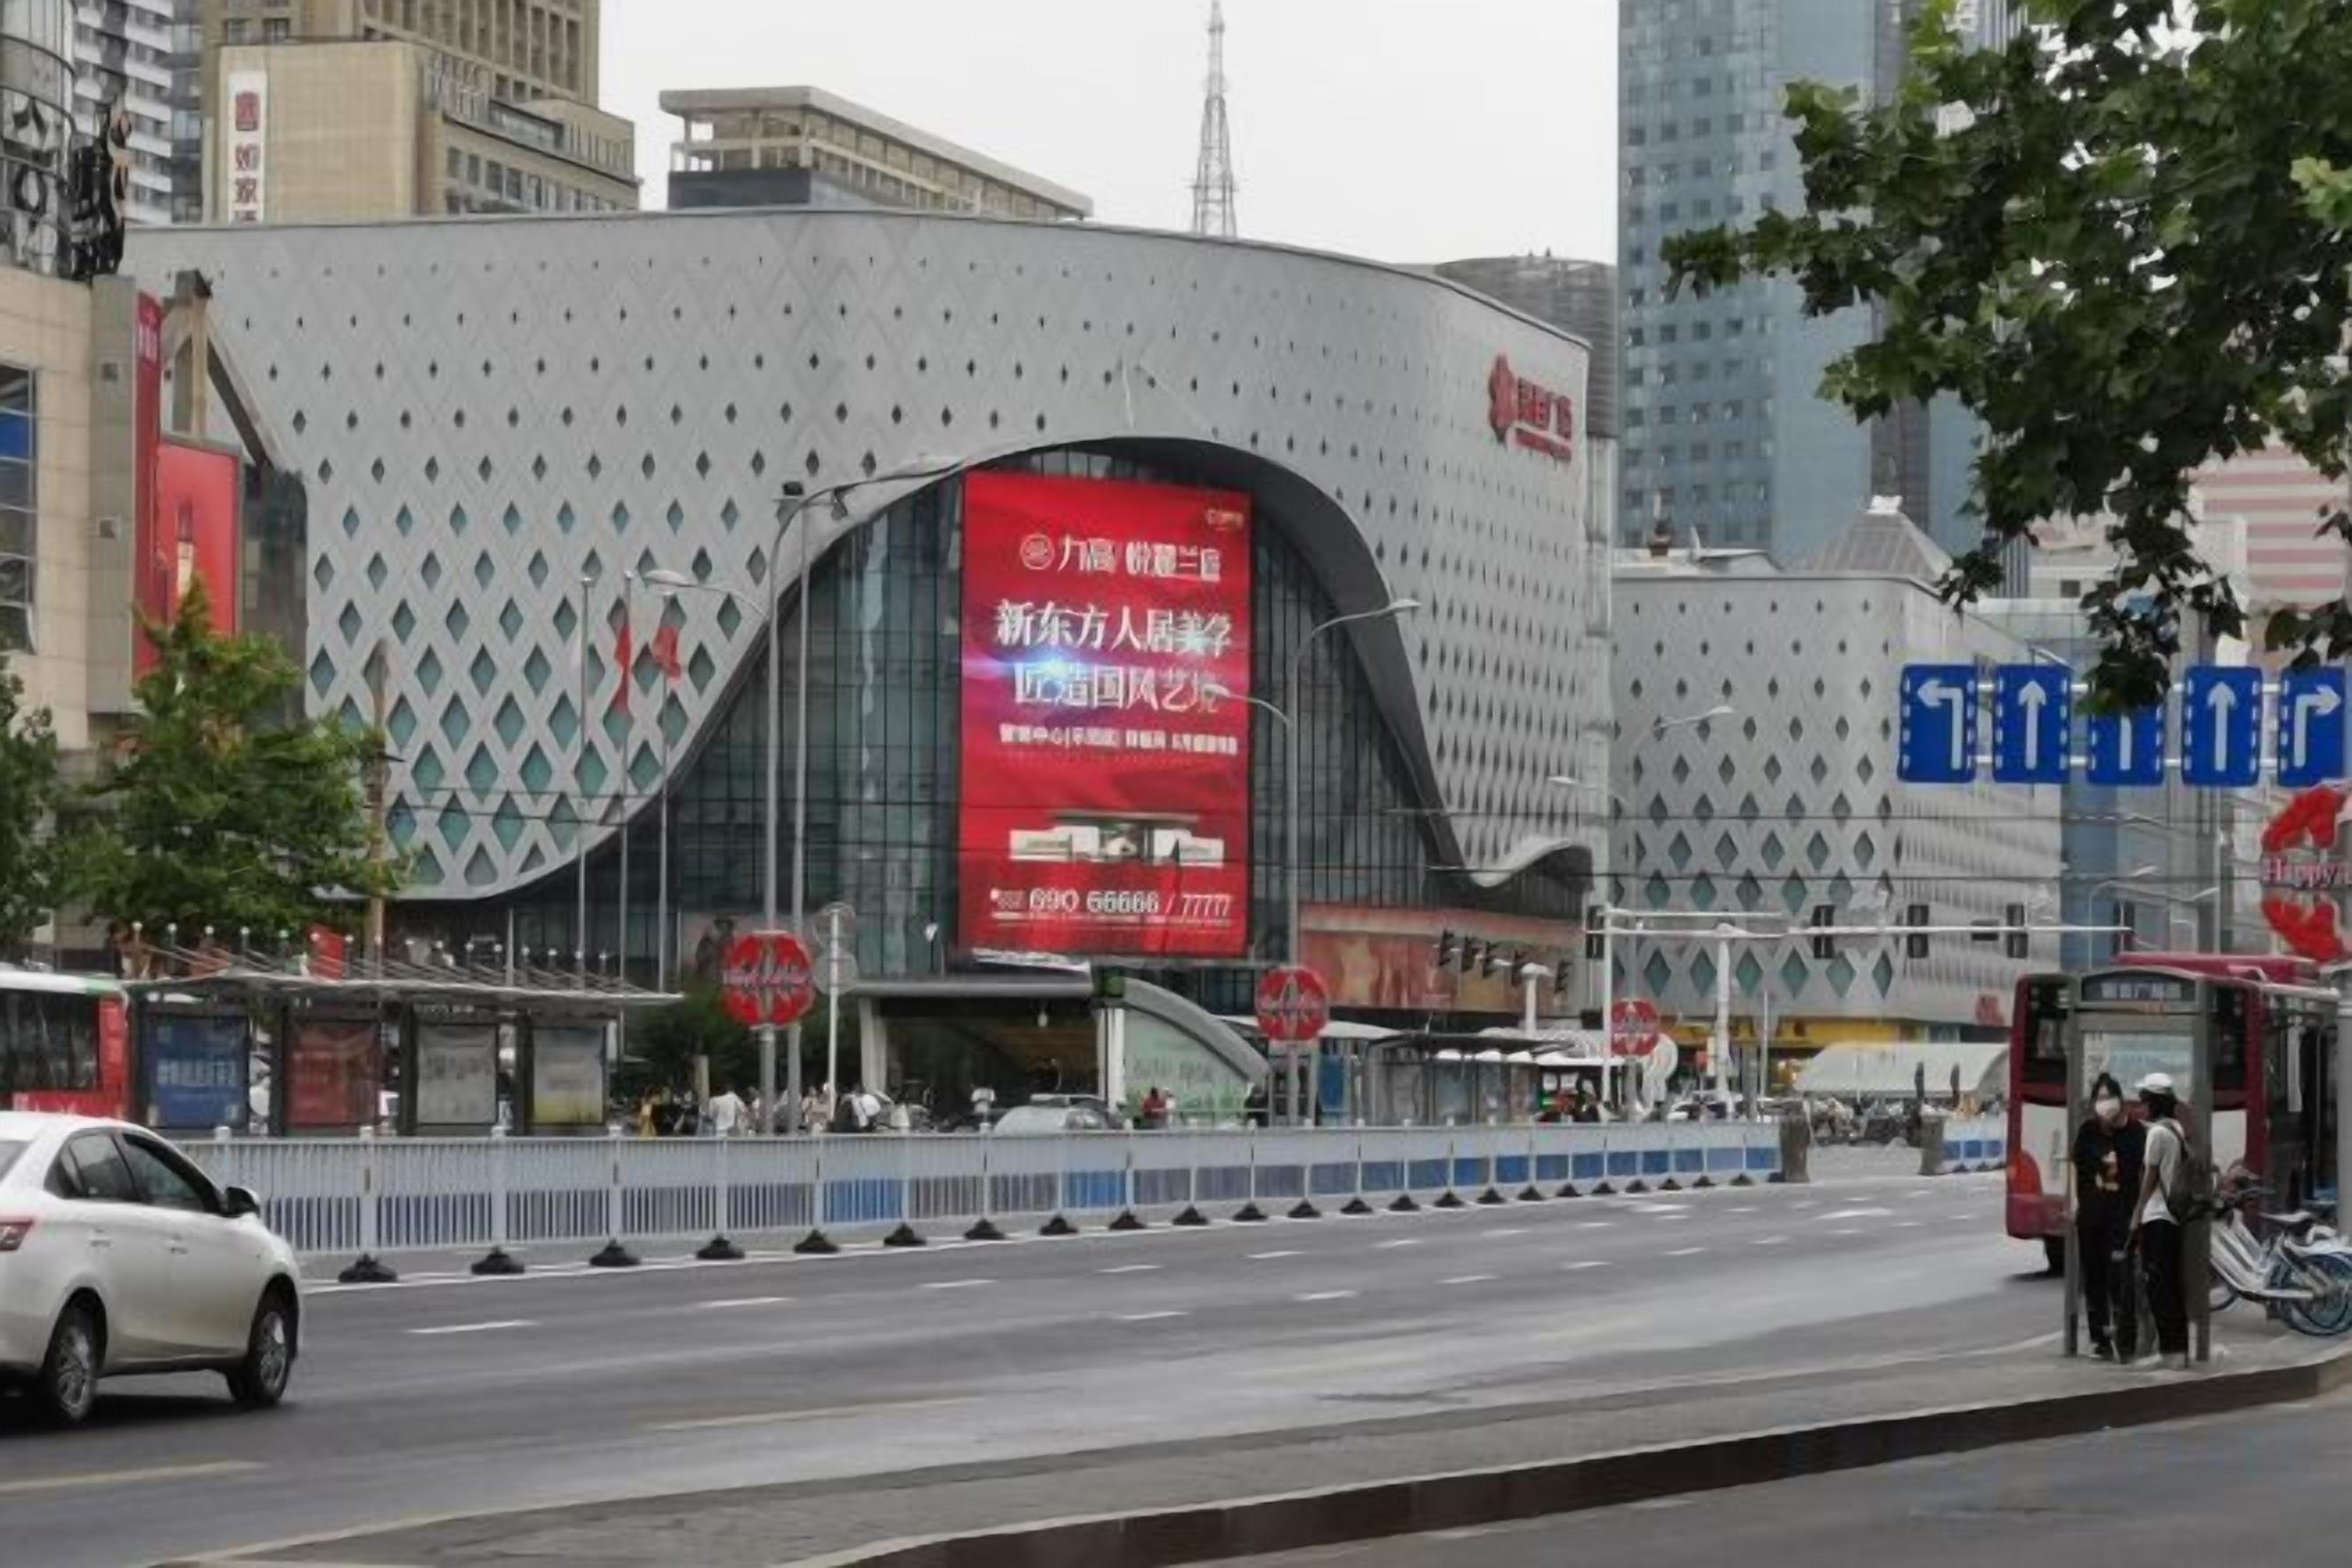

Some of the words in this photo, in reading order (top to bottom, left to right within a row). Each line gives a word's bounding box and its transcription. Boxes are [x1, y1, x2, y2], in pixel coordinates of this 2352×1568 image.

[996, 598, 1233, 657] 新东方人居美学
